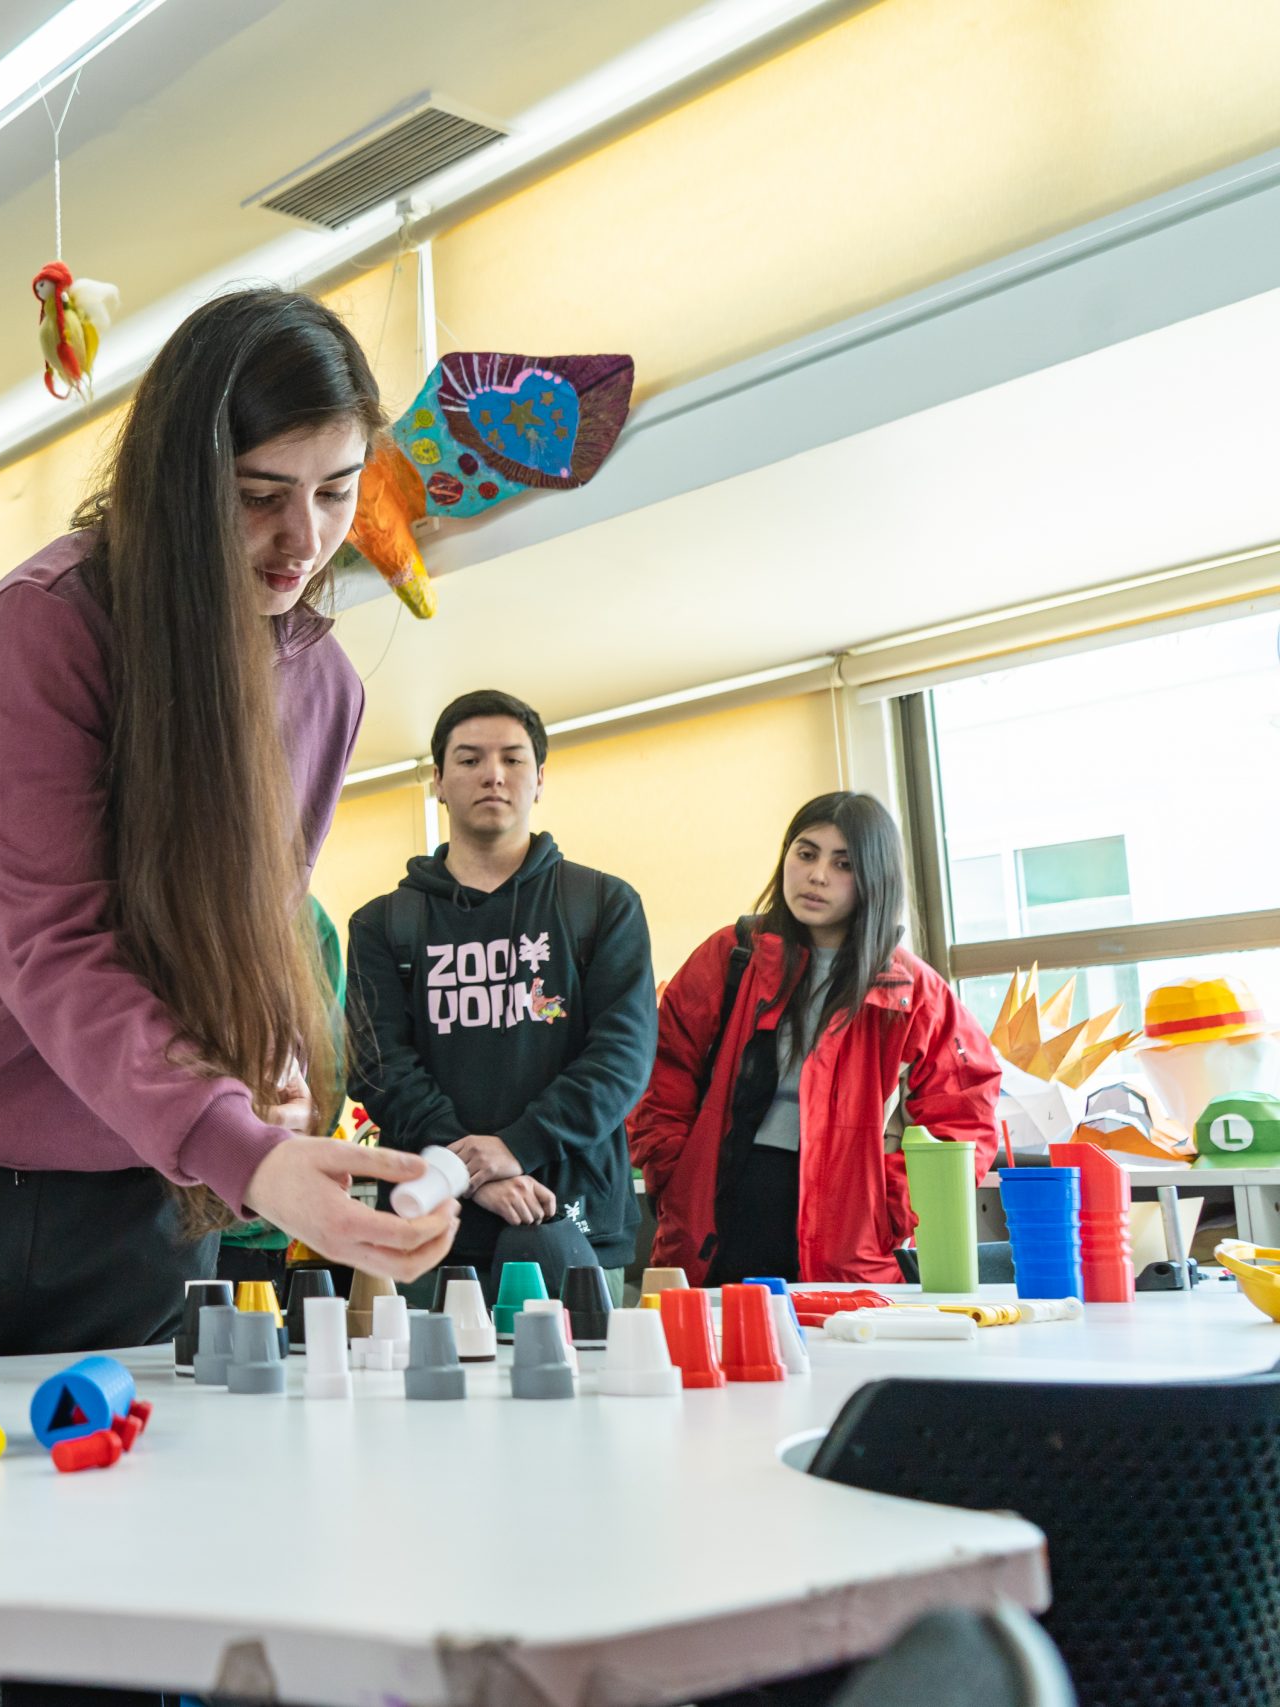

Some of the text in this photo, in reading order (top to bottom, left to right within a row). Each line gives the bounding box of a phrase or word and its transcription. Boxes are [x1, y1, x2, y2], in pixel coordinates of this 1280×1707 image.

[426, 938, 517, 987] ZOO
[427, 981, 544, 1035] YORK
[1222, 1119, 1244, 1145] L
